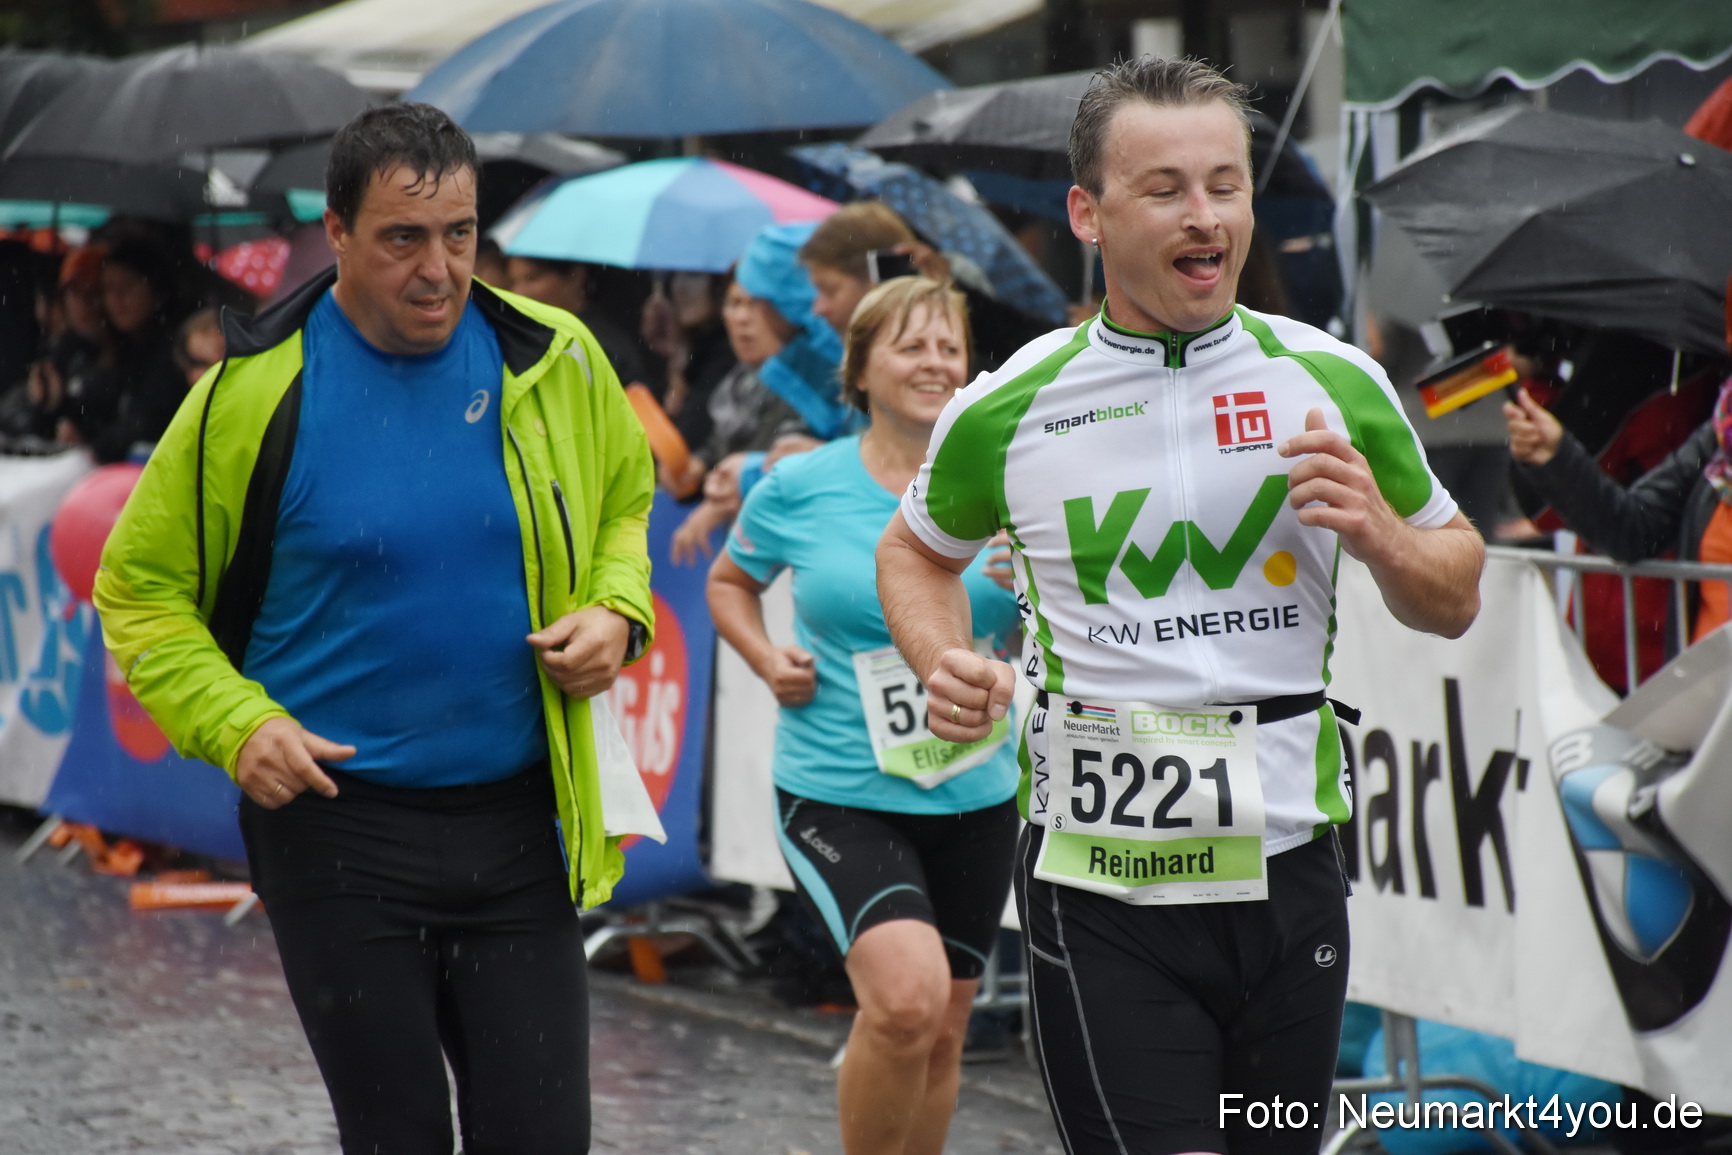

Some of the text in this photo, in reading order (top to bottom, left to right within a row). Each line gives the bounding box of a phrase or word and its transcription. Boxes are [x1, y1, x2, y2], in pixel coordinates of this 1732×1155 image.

[1044, 402, 1146, 435] smartblock
[1218, 443, 1273, 454] TU-SPORTS
[1088, 604, 1300, 645] KW ENERGIE
[1063, 719, 1121, 737] NeuerMarkt
[1131, 711, 1235, 737] BOCK
[1132, 736, 1237, 748] inspired by smart concepts
[1070, 748, 1234, 829] 5221
[1054, 815, 1064, 829] S
[1088, 845, 1215, 880] Reinhard
